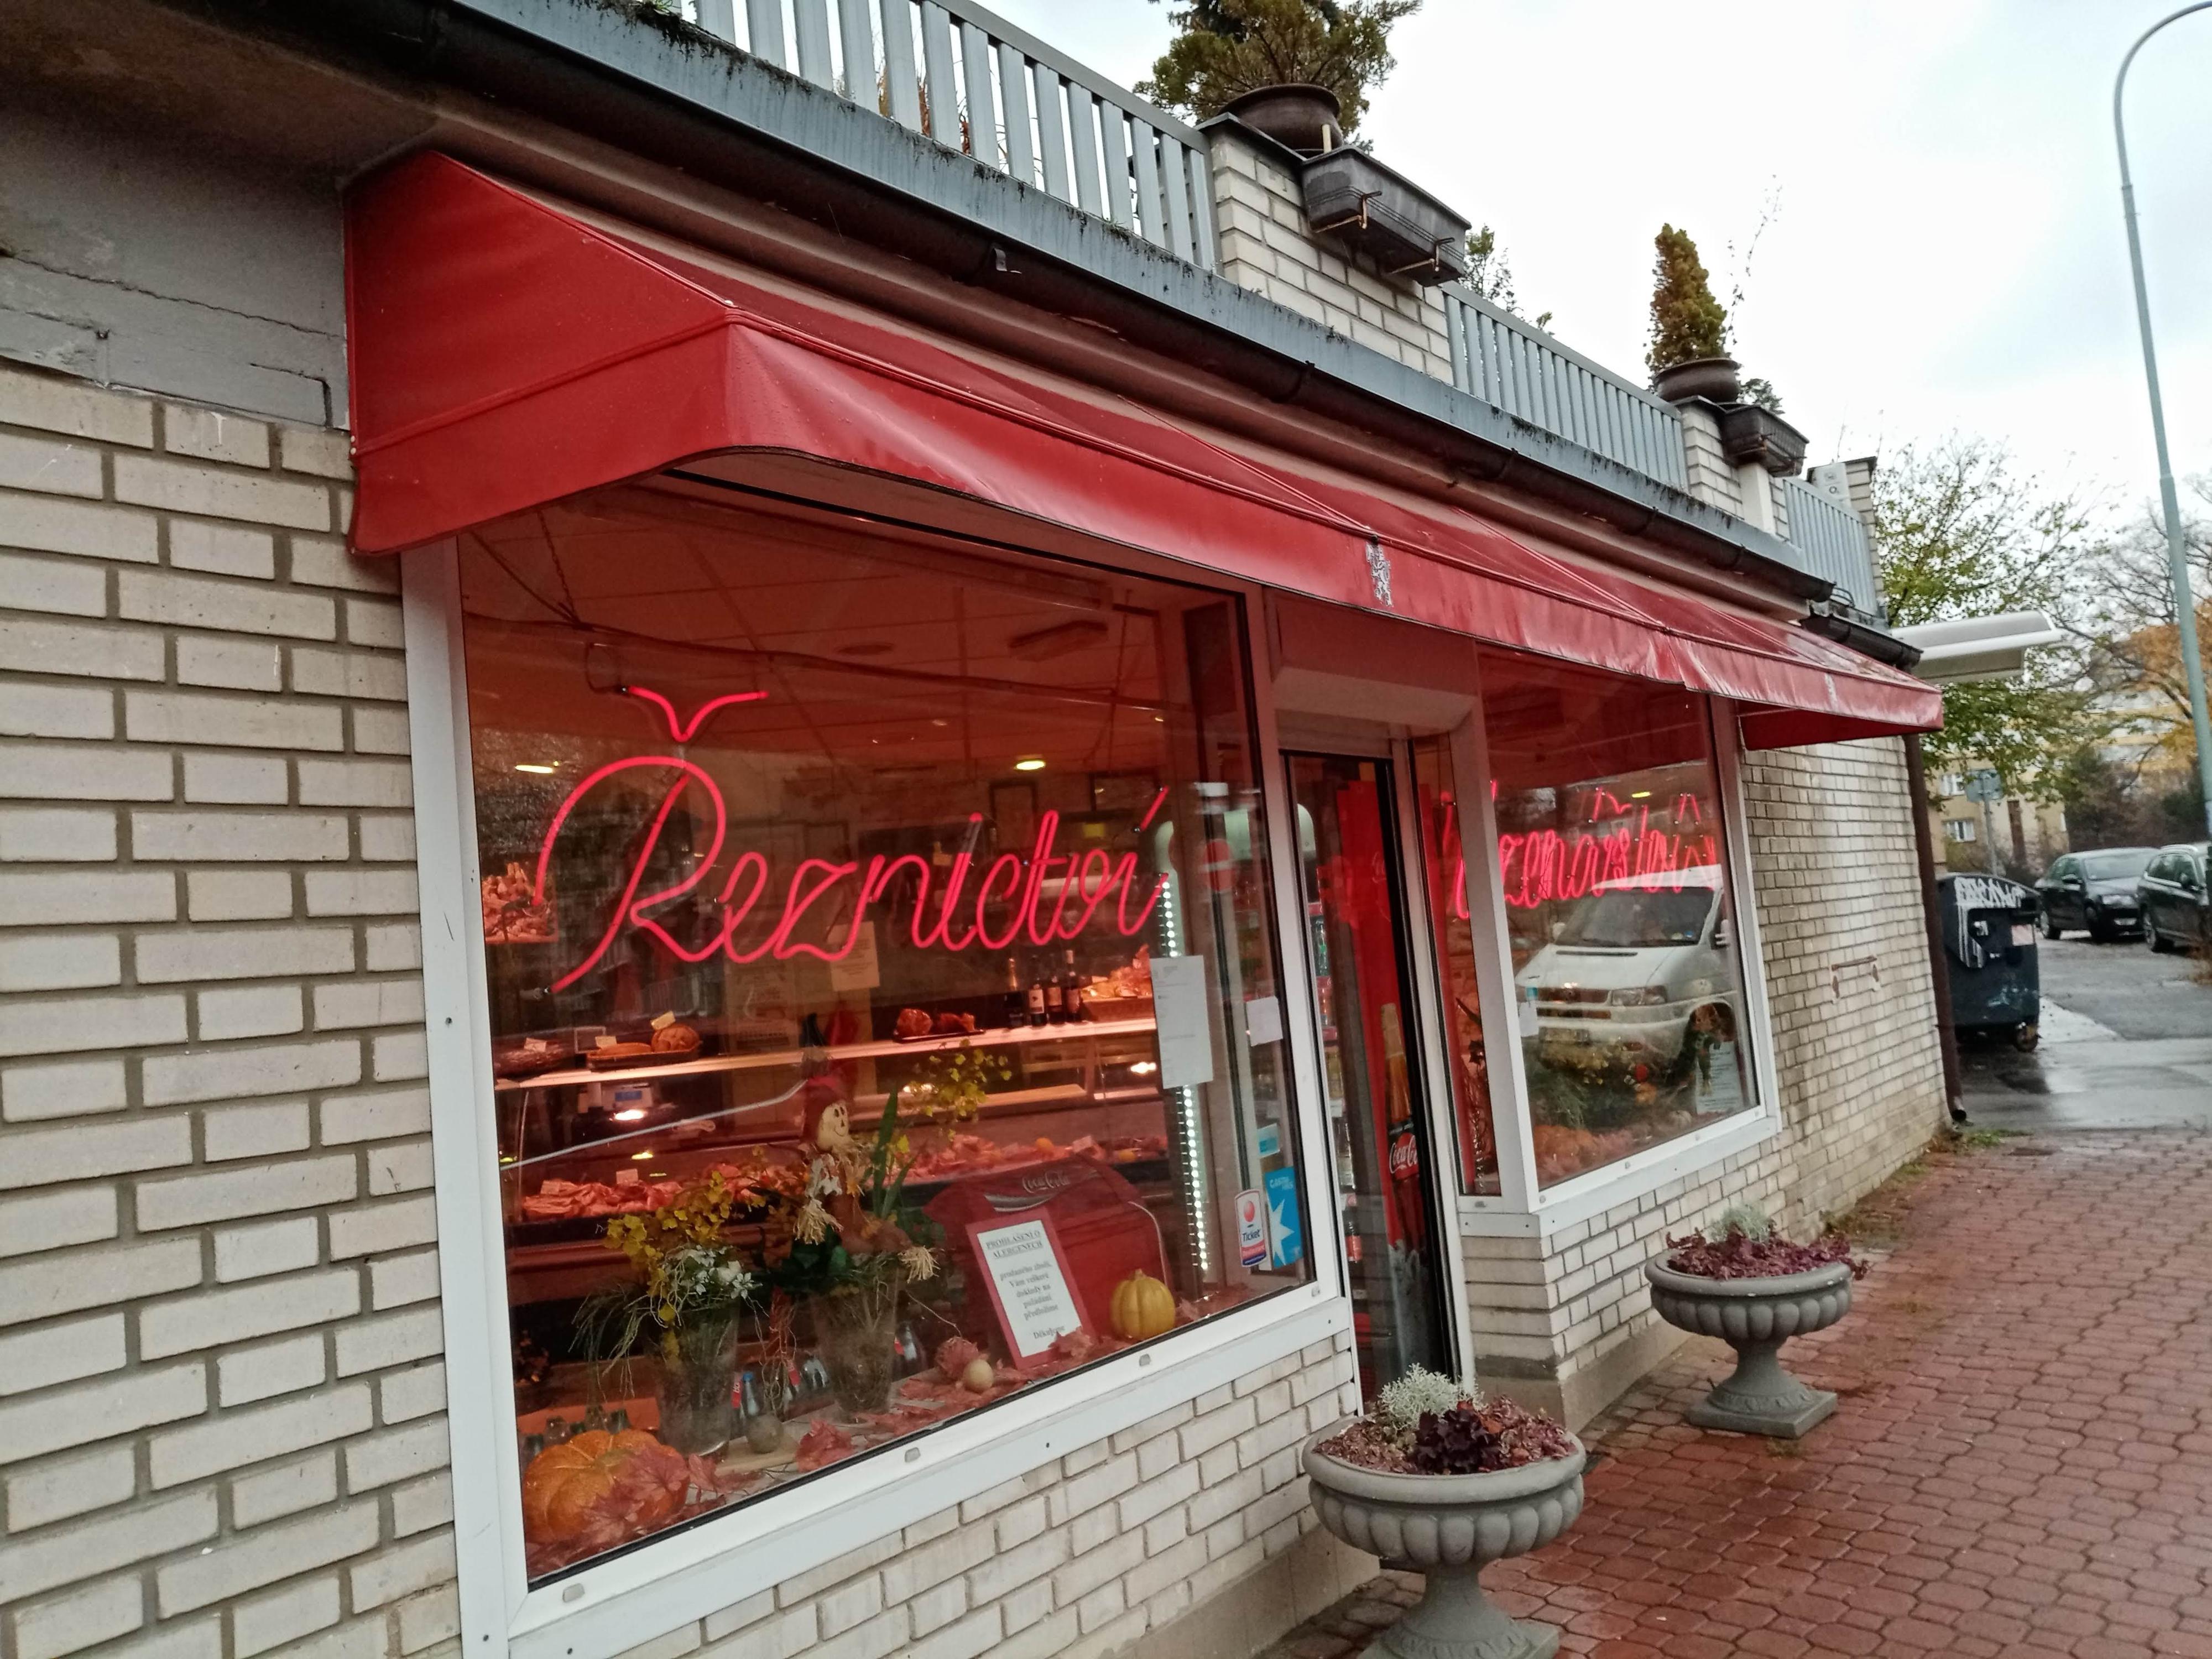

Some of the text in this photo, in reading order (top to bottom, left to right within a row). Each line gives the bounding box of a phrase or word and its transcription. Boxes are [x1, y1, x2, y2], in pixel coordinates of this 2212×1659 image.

[533, 686, 1170, 993] Řeznictví
[1242, 1229, 1260, 1242] Ticket
[993, 1240, 1043, 1258] ALERGENECH
